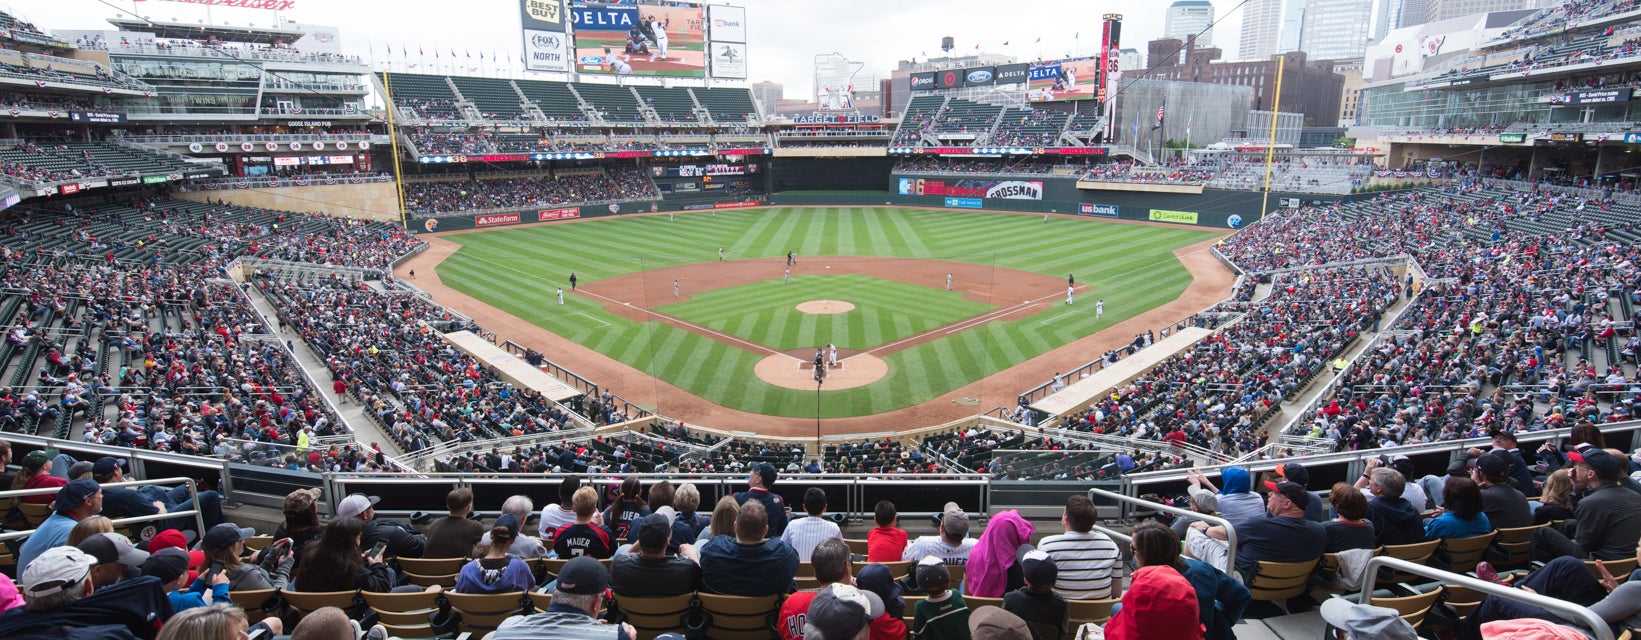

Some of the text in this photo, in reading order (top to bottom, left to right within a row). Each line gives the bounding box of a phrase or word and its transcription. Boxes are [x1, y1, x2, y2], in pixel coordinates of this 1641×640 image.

[530, 0, 559, 12] BEST
[531, 8, 557, 18] BUY
[537, 36, 554, 45] FOX
[534, 52, 560, 62] NORTH
[1108, 59, 1118, 72] 36
[918, 76, 934, 84] pepsi
[906, 178, 925, 195] 36
[990, 185, 1038, 199] GROSSMAN
[1082, 204, 1116, 215] usbank
[616, 522, 630, 538] 7
[566, 536, 591, 548] MAUER
